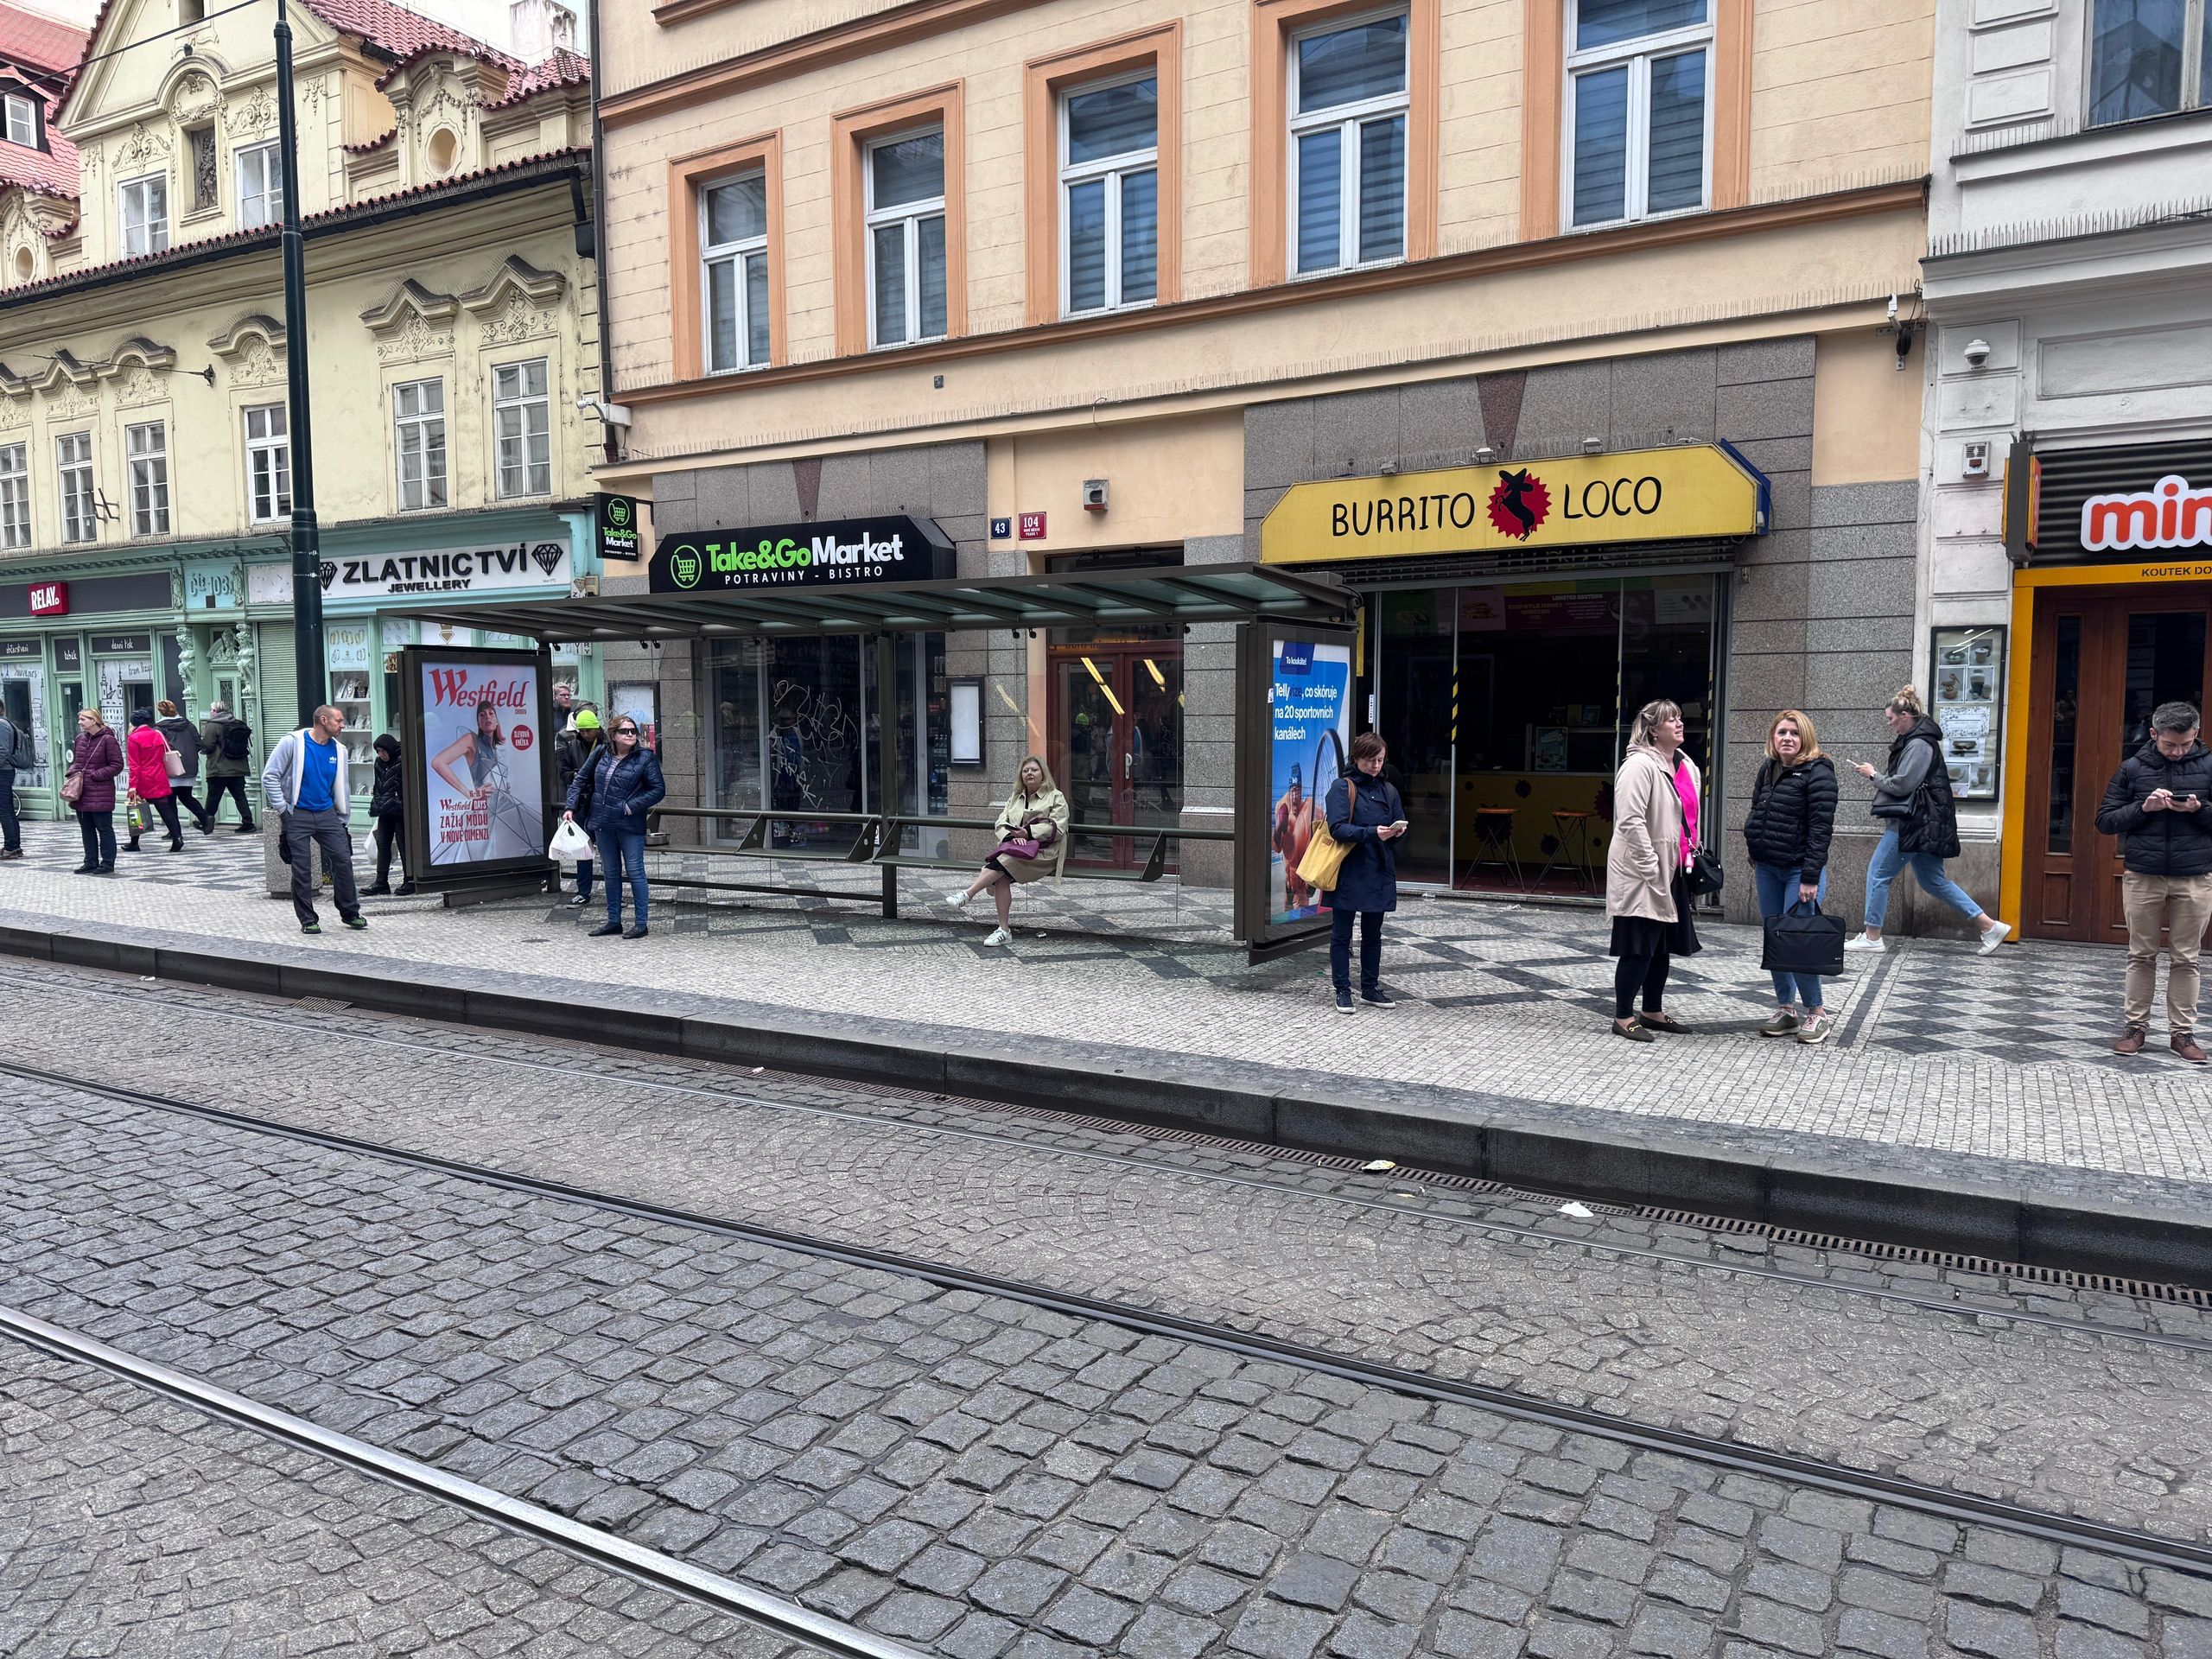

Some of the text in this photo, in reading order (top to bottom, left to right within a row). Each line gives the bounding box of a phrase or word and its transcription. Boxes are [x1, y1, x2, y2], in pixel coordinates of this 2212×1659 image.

[1332, 476, 1662, 537] BURRITO LOCO
[995, 523, 1006, 534] 43
[1024, 516, 1039, 528] 104
[602, 526, 637, 539] Take&Go
[606, 536, 633, 548] Market
[342, 543, 527, 584] ZLATNICTVÍ
[725, 570, 805, 585] POTRAVINY
[829, 565, 883, 580] BISTRO
[2141, 567, 2191, 577] KOUTEK
[387, 578, 471, 594] JEWELLERY
[31, 586, 56, 611] RELAY
[429, 668, 531, 708] Westfield
[1305, 687, 1313, 698] co
[1314, 684, 1338, 701] skóruje
[1274, 705, 1333, 721] na 20 sportovních
[1274, 726, 1306, 741] kanálech
[440, 798, 487, 811] Westfield DAYS
